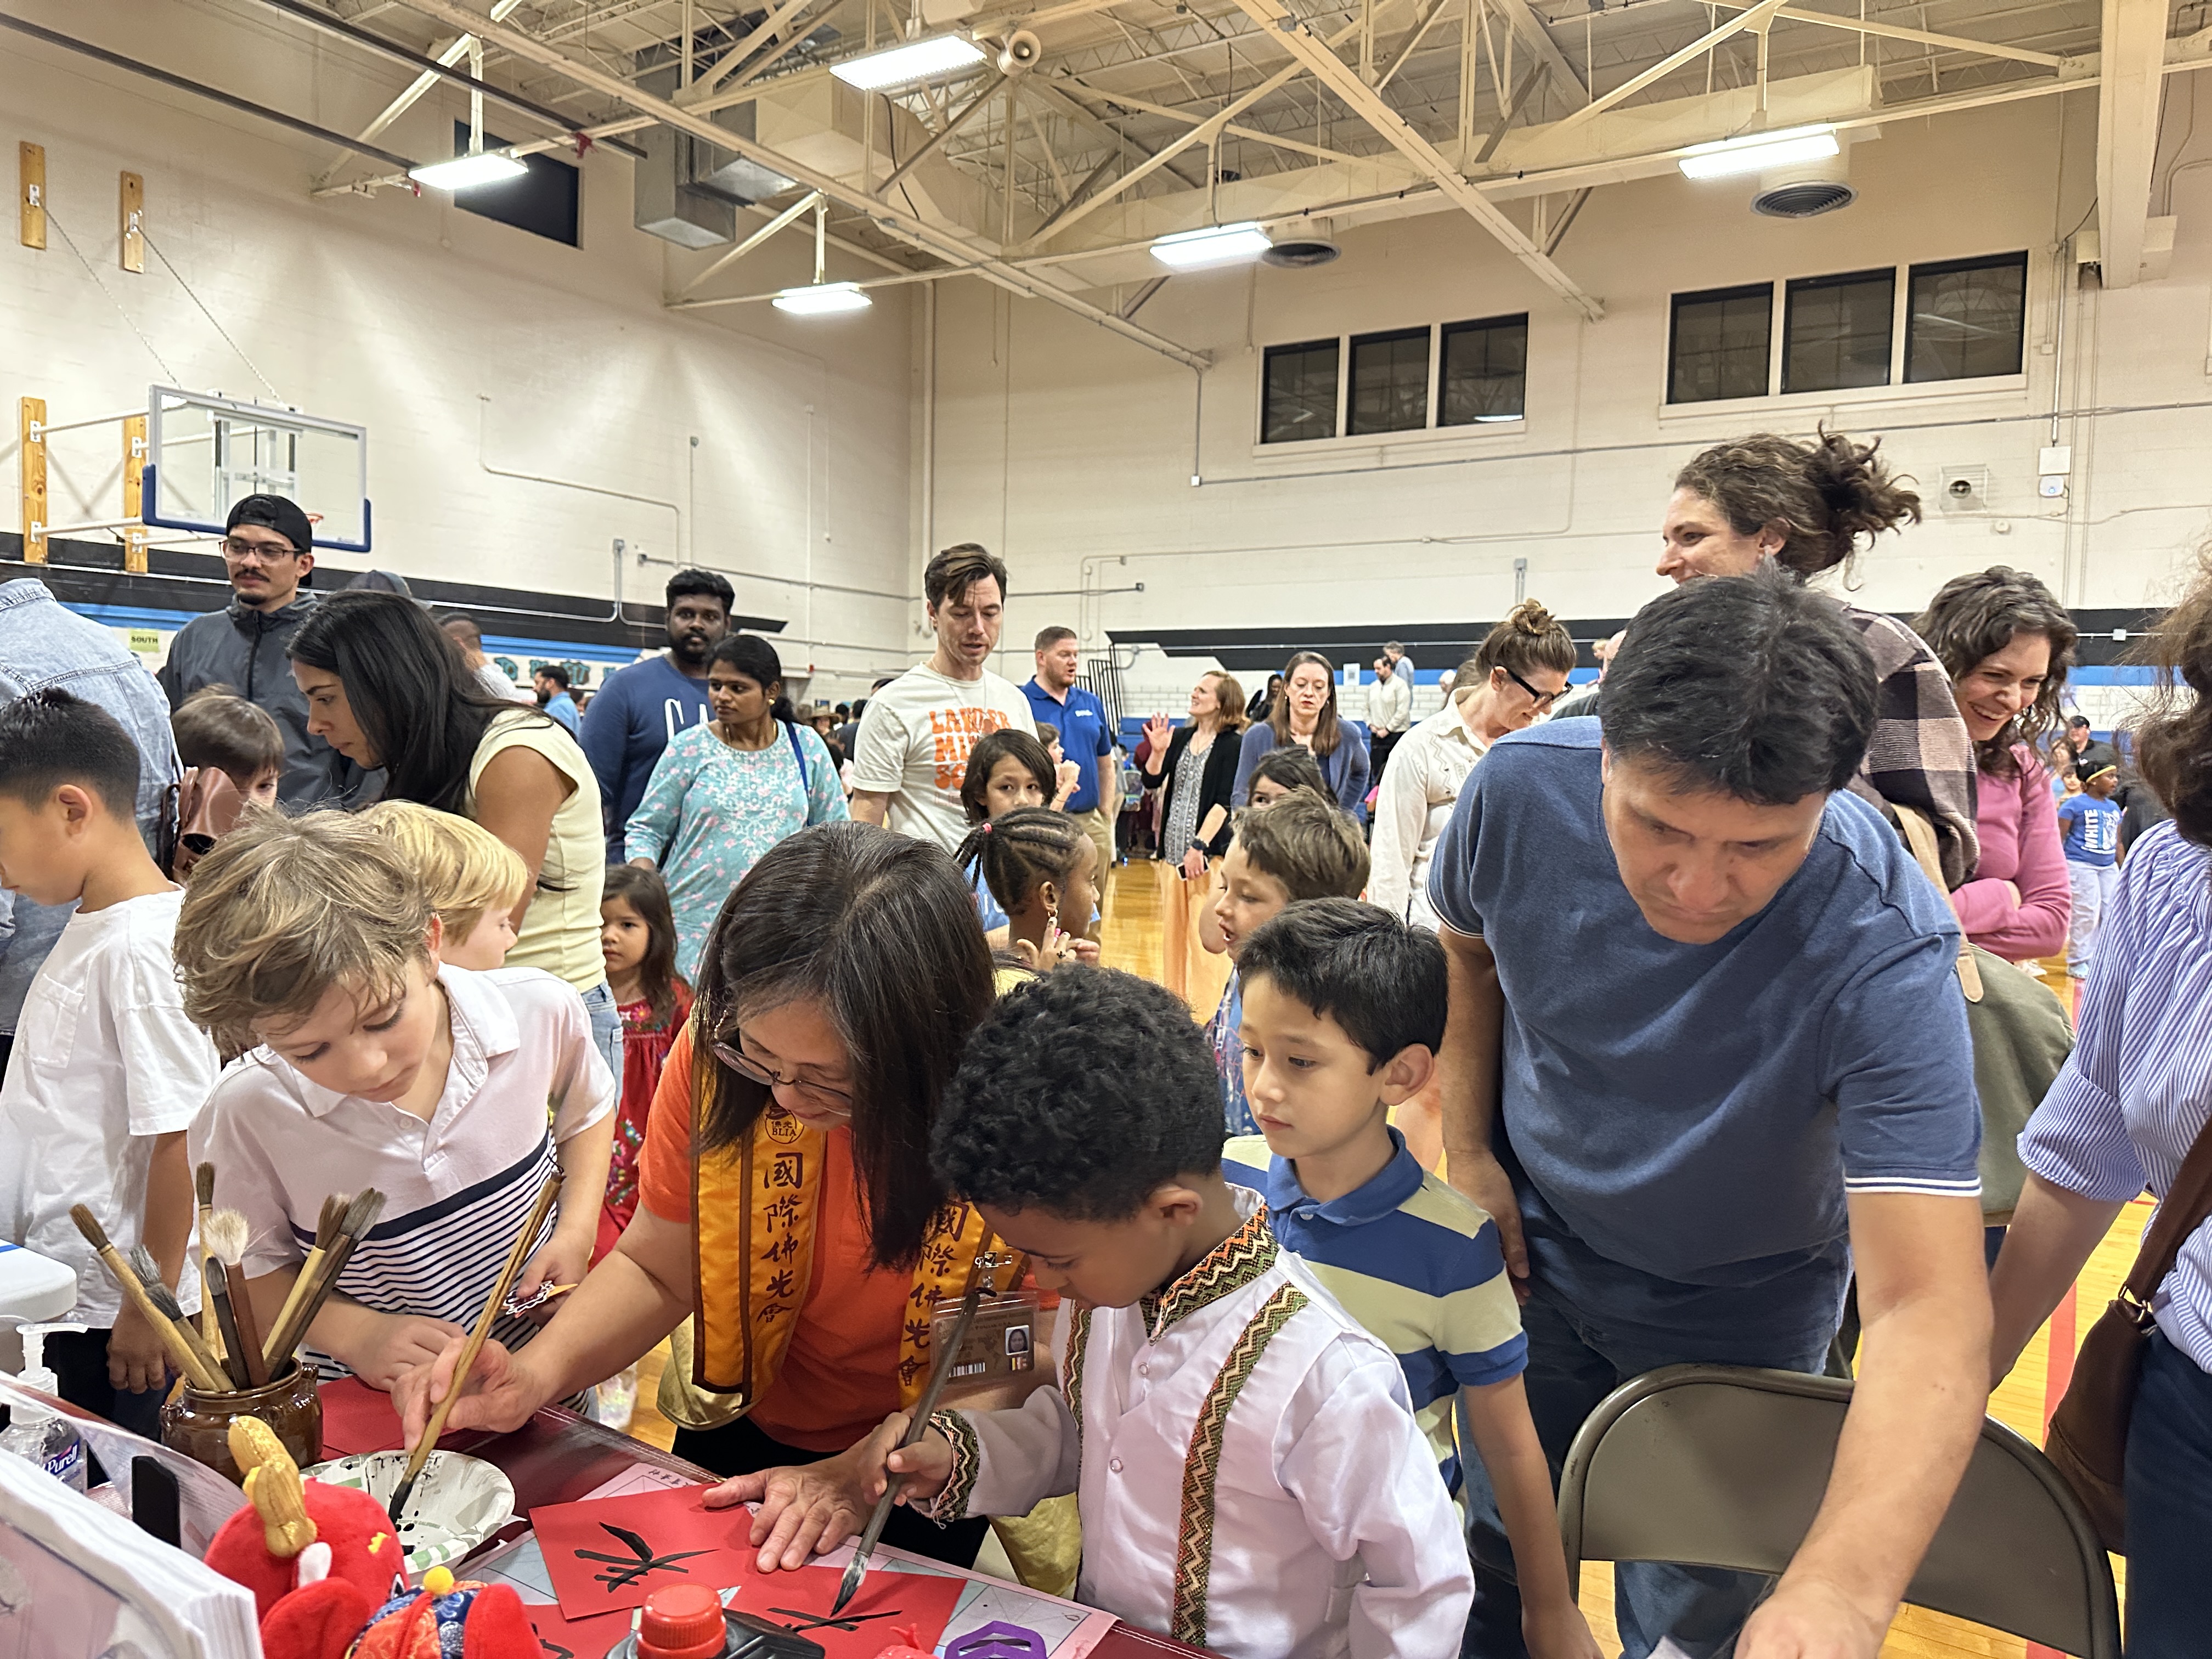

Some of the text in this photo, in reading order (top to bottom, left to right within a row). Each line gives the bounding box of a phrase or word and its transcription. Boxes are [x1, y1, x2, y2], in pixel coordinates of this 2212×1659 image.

[2084, 809, 2098, 849] WHITE
[772, 1128, 797, 1136] BLIA
[757, 1153, 803, 1323] 國際佛光會
